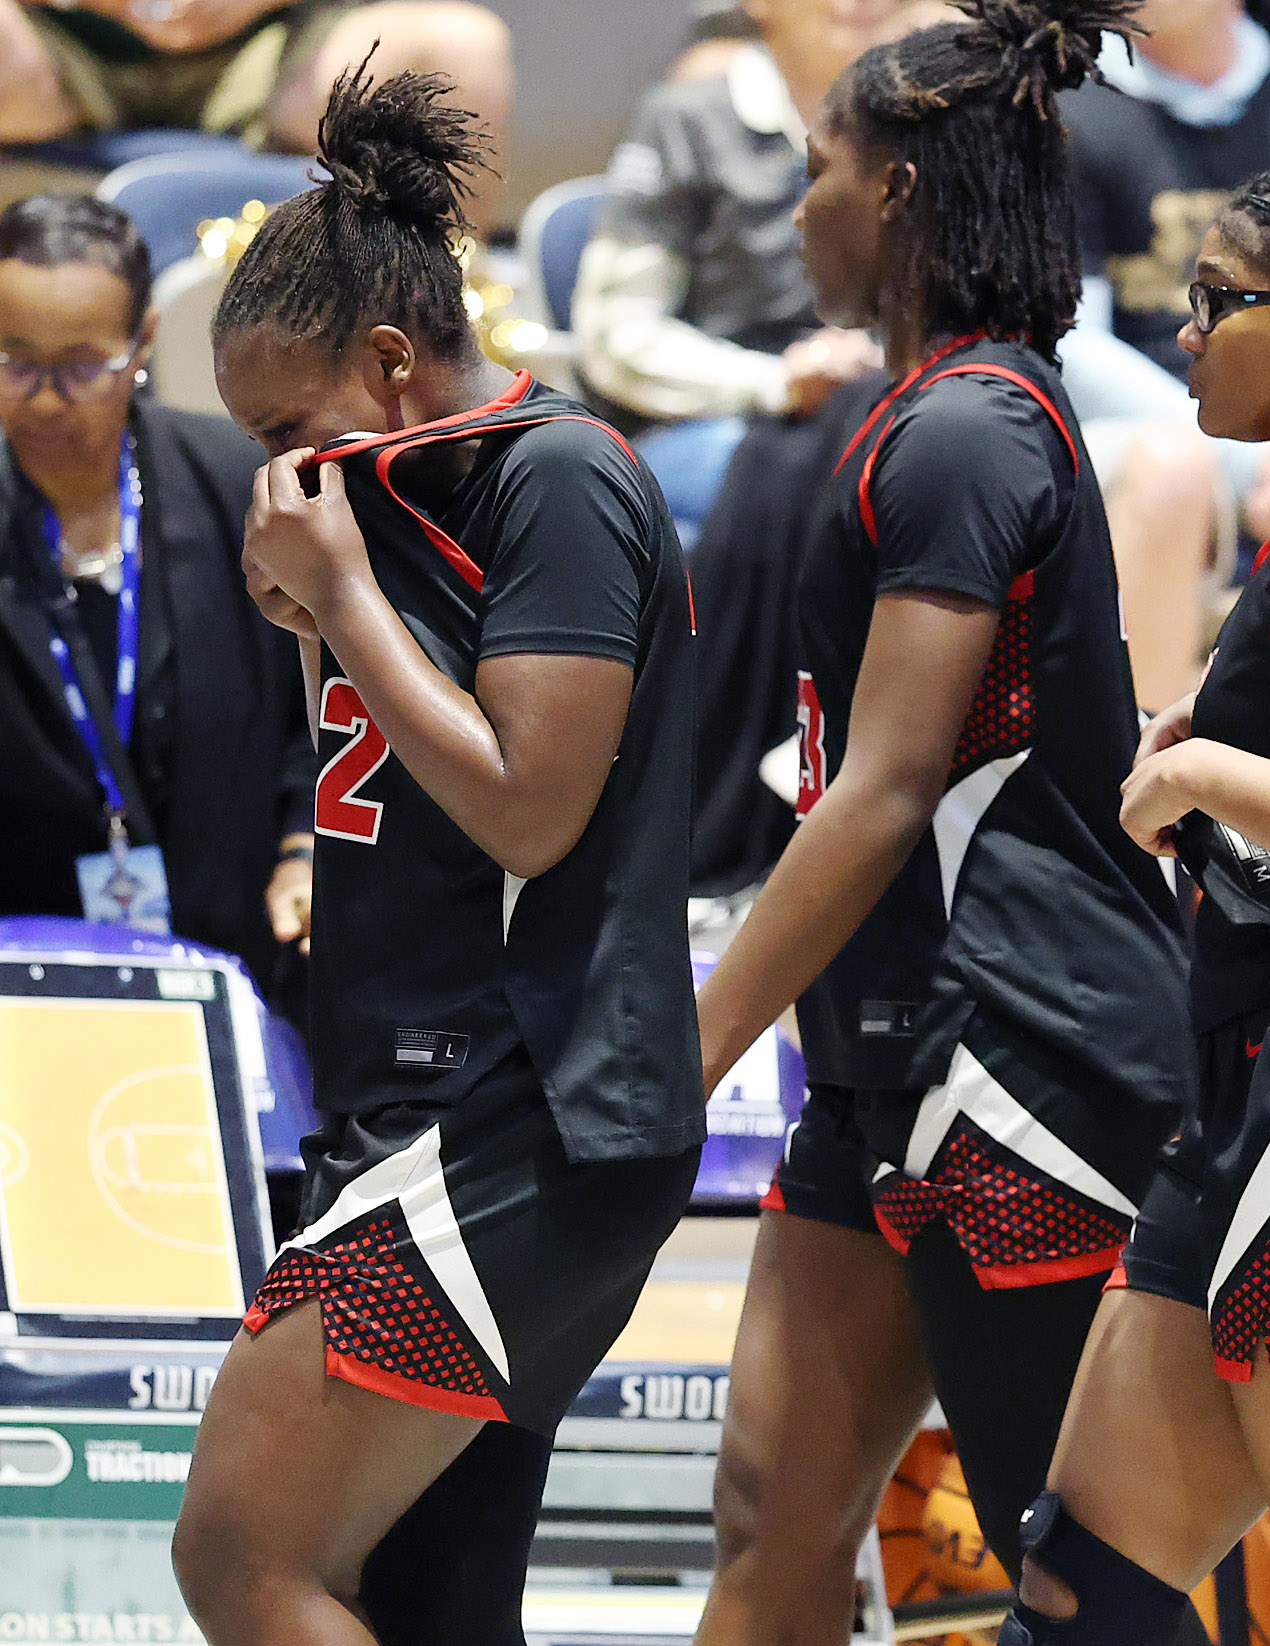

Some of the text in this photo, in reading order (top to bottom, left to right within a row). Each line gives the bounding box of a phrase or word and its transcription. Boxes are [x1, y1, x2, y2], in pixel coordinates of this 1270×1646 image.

[315, 677, 390, 845] 2
[1253, 865, 1270, 882] M
[446, 1043, 455, 1058] L
[55, 1613, 174, 1641] STARTS
